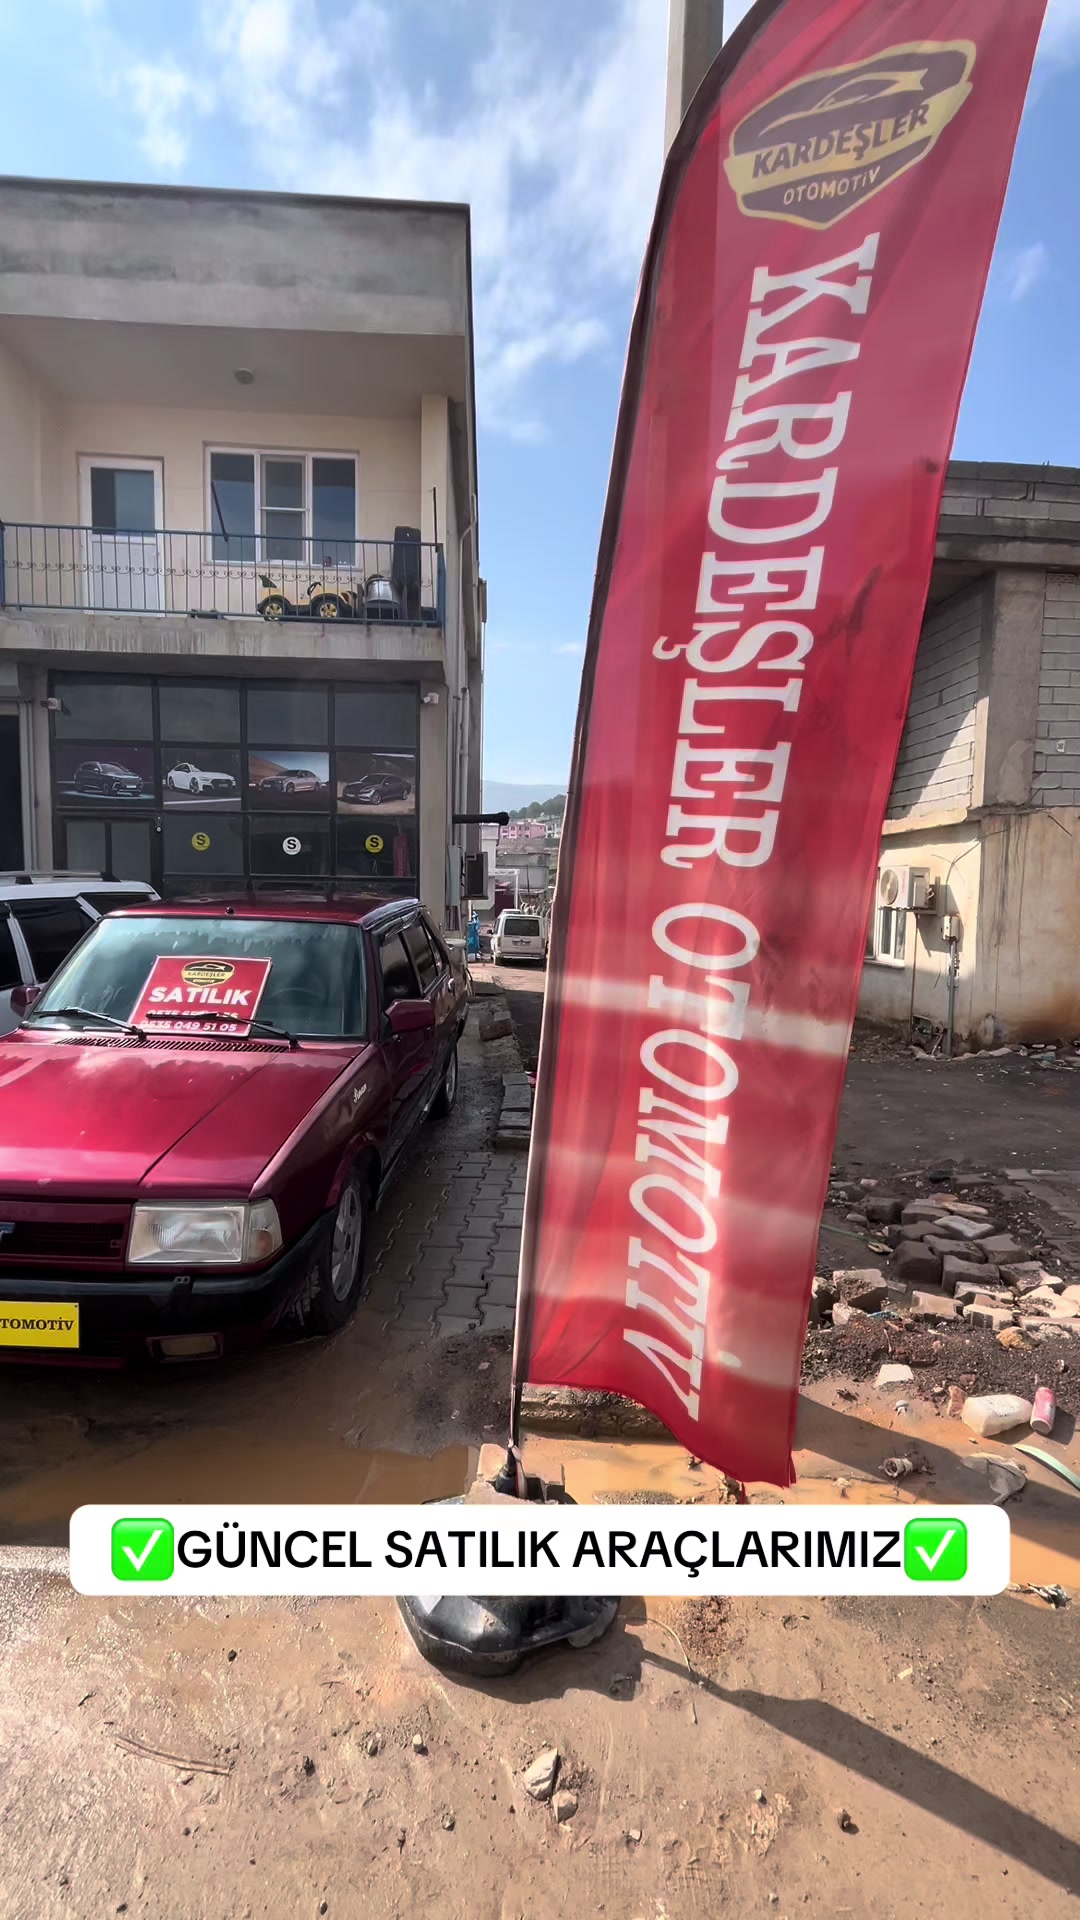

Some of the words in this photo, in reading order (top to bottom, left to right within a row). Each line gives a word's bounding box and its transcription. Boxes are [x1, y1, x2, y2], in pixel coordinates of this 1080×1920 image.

[752, 104, 929, 180] KARDEŞLER
[783, 166, 880, 206] OTOMOTİV
[653, 232, 880, 869] KARDEŞLER
[196, 834, 206, 846] S
[287, 838, 297, 850] S
[370, 836, 380, 848] S
[148, 986, 252, 1006] SATILIK
[173, 1021, 200, 1030] 049
[203, 1022, 217, 1031] 51
[219, 1023, 237, 1032] 05
[623, 902, 760, 1421] OTOMOTİV
